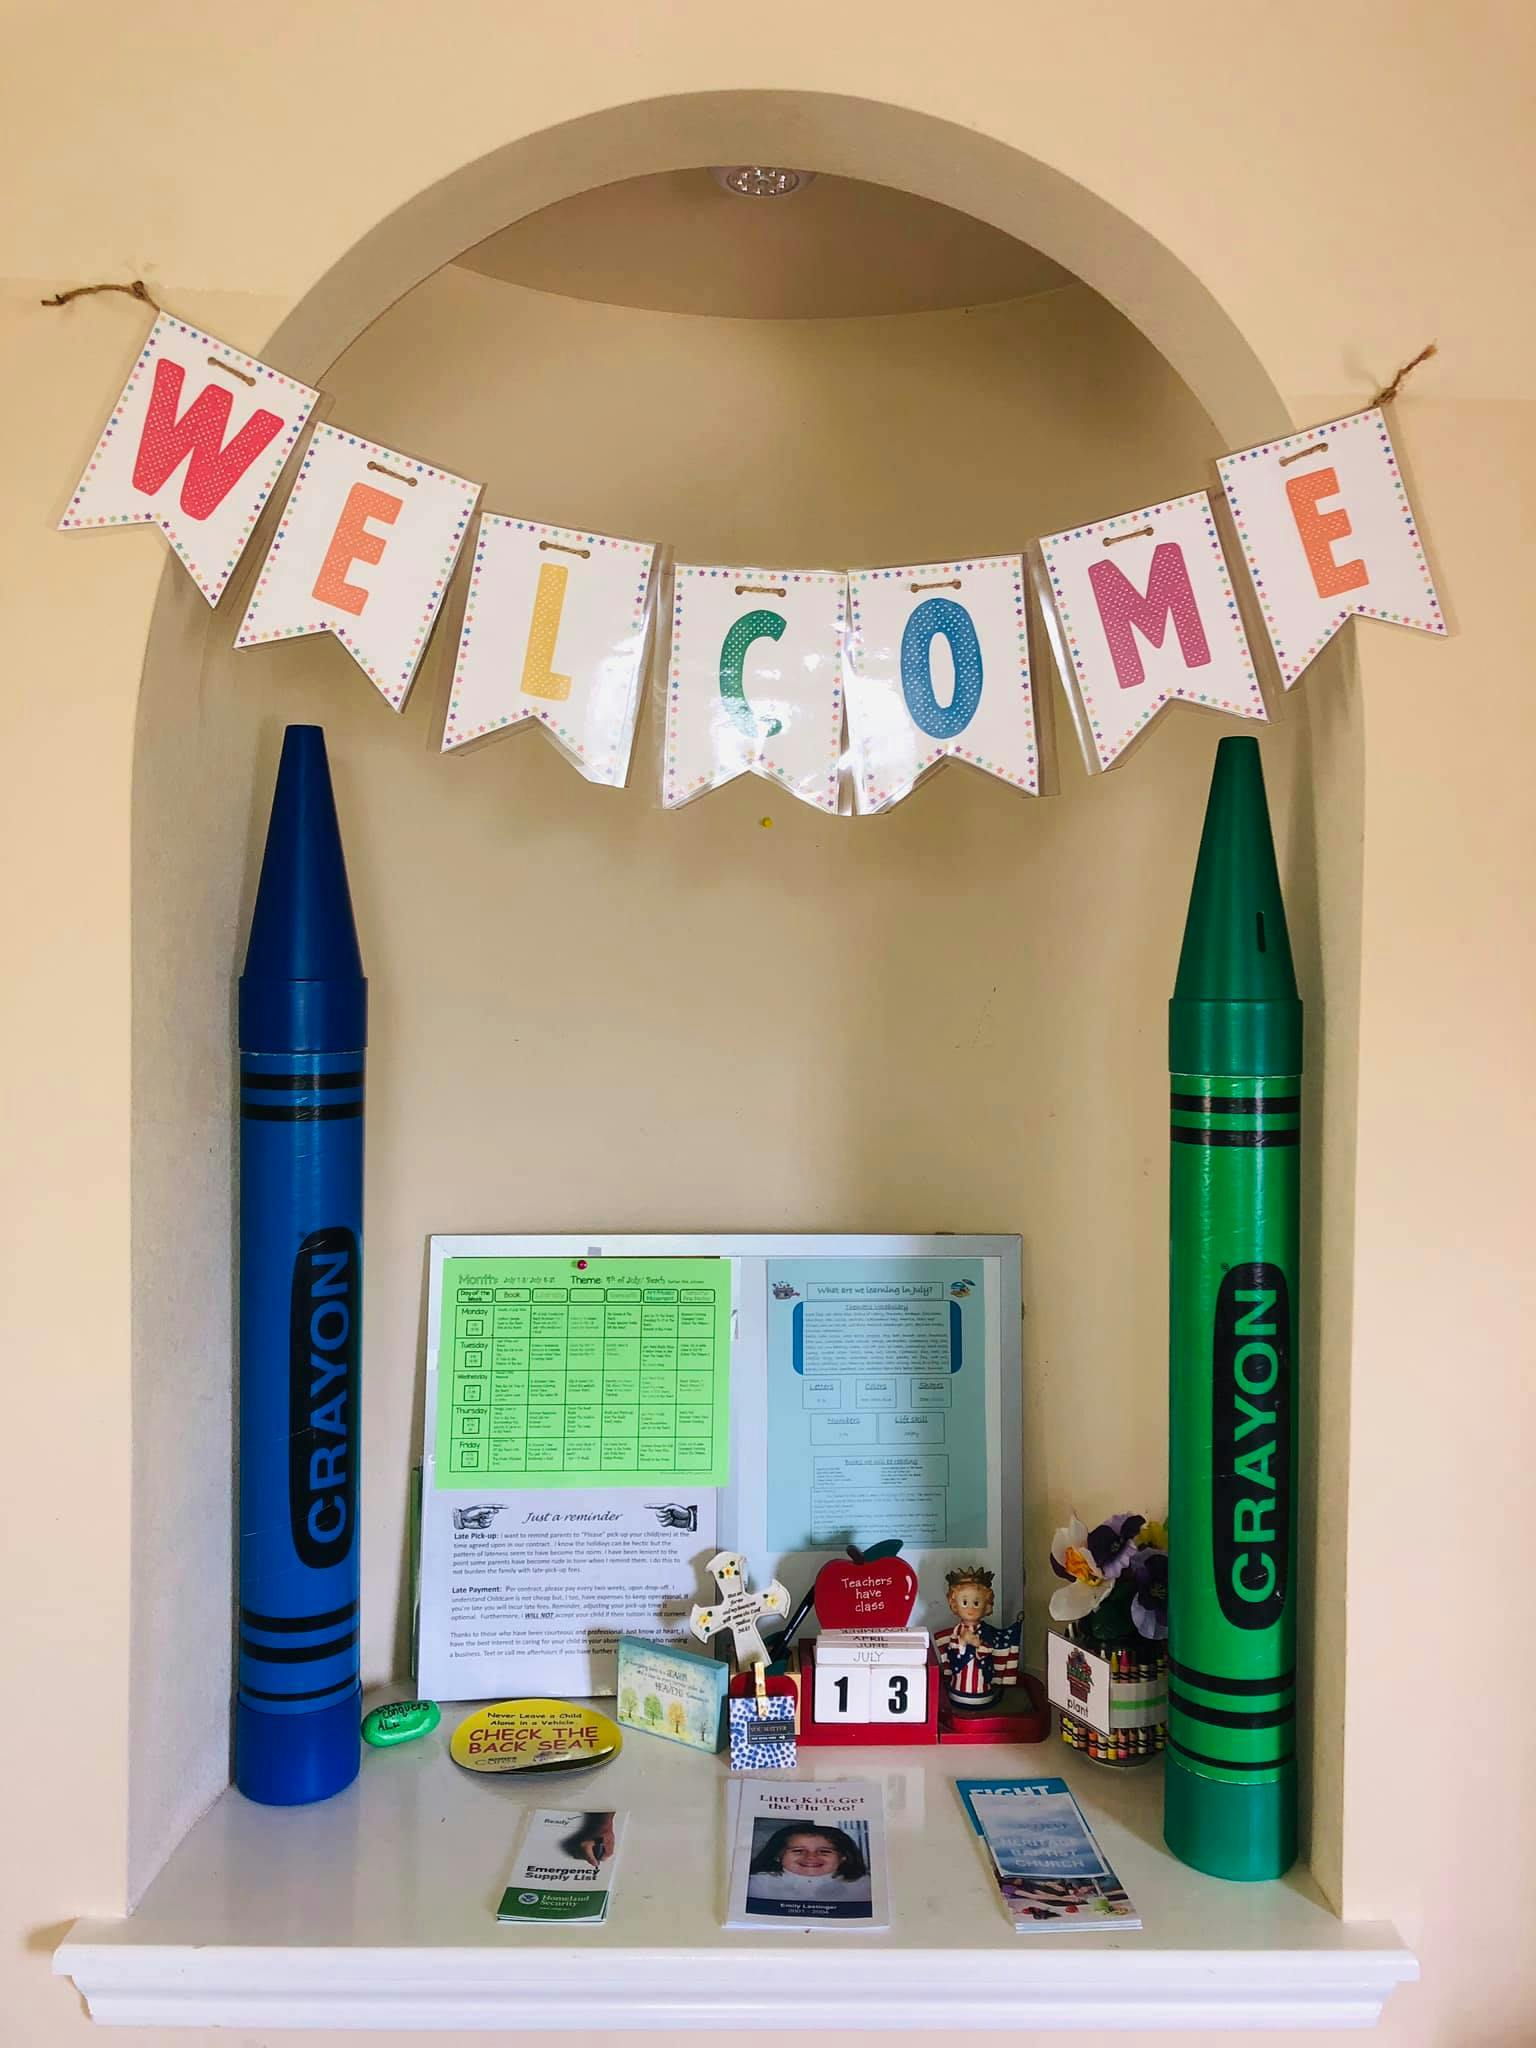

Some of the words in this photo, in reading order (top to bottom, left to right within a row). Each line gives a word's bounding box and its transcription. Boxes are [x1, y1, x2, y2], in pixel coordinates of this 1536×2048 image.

[132, 358, 1370, 739] WELCOME
[817, 1285, 840, 1294] What
[866, 1285, 900, 1296] learning
[902, 1285, 911, 1294] in
[911, 1285, 933, 1296] July?
[462, 1308, 488, 1316] Monday
[460, 1342, 488, 1350] Tuesday
[307, 1250, 348, 1544] CRAYON
[456, 1408, 488, 1416] Thursday
[459, 1441, 480, 1450] Friday
[1231, 1289, 1279, 1603] CRAYON
[522, 1512, 551, 1524] Just
[551, 1514, 561, 1522] a
[564, 1511, 624, 1522] reminder
[841, 1576, 892, 1589] Teachers
[468, 1586, 502, 1595] Payment:
[855, 1588, 882, 1599] have
[855, 1600, 885, 1613] class
[853, 1651, 885, 1663] JULY
[834, 1676, 849, 1713] 1
[888, 1675, 909, 1715] 3
[1067, 1698, 1089, 1718] plant
[469, 1728, 542, 1741] CHECK
[552, 1726, 598, 1739] THE
[468, 1740, 527, 1754] BACK
[537, 1739, 600, 1751] SEAT
[760, 1794, 798, 1803] Little
[802, 1796, 835, 1804] Kids
[823, 1804, 856, 1812] Too!
[544, 1818, 569, 1826] Ready
[1015, 1859, 1085, 1868] CHURCH
[527, 1865, 601, 1876] Emergency
[525, 1872, 570, 1881] Supply
[573, 1873, 598, 1881] List
[540, 1900, 578, 1908] Security
